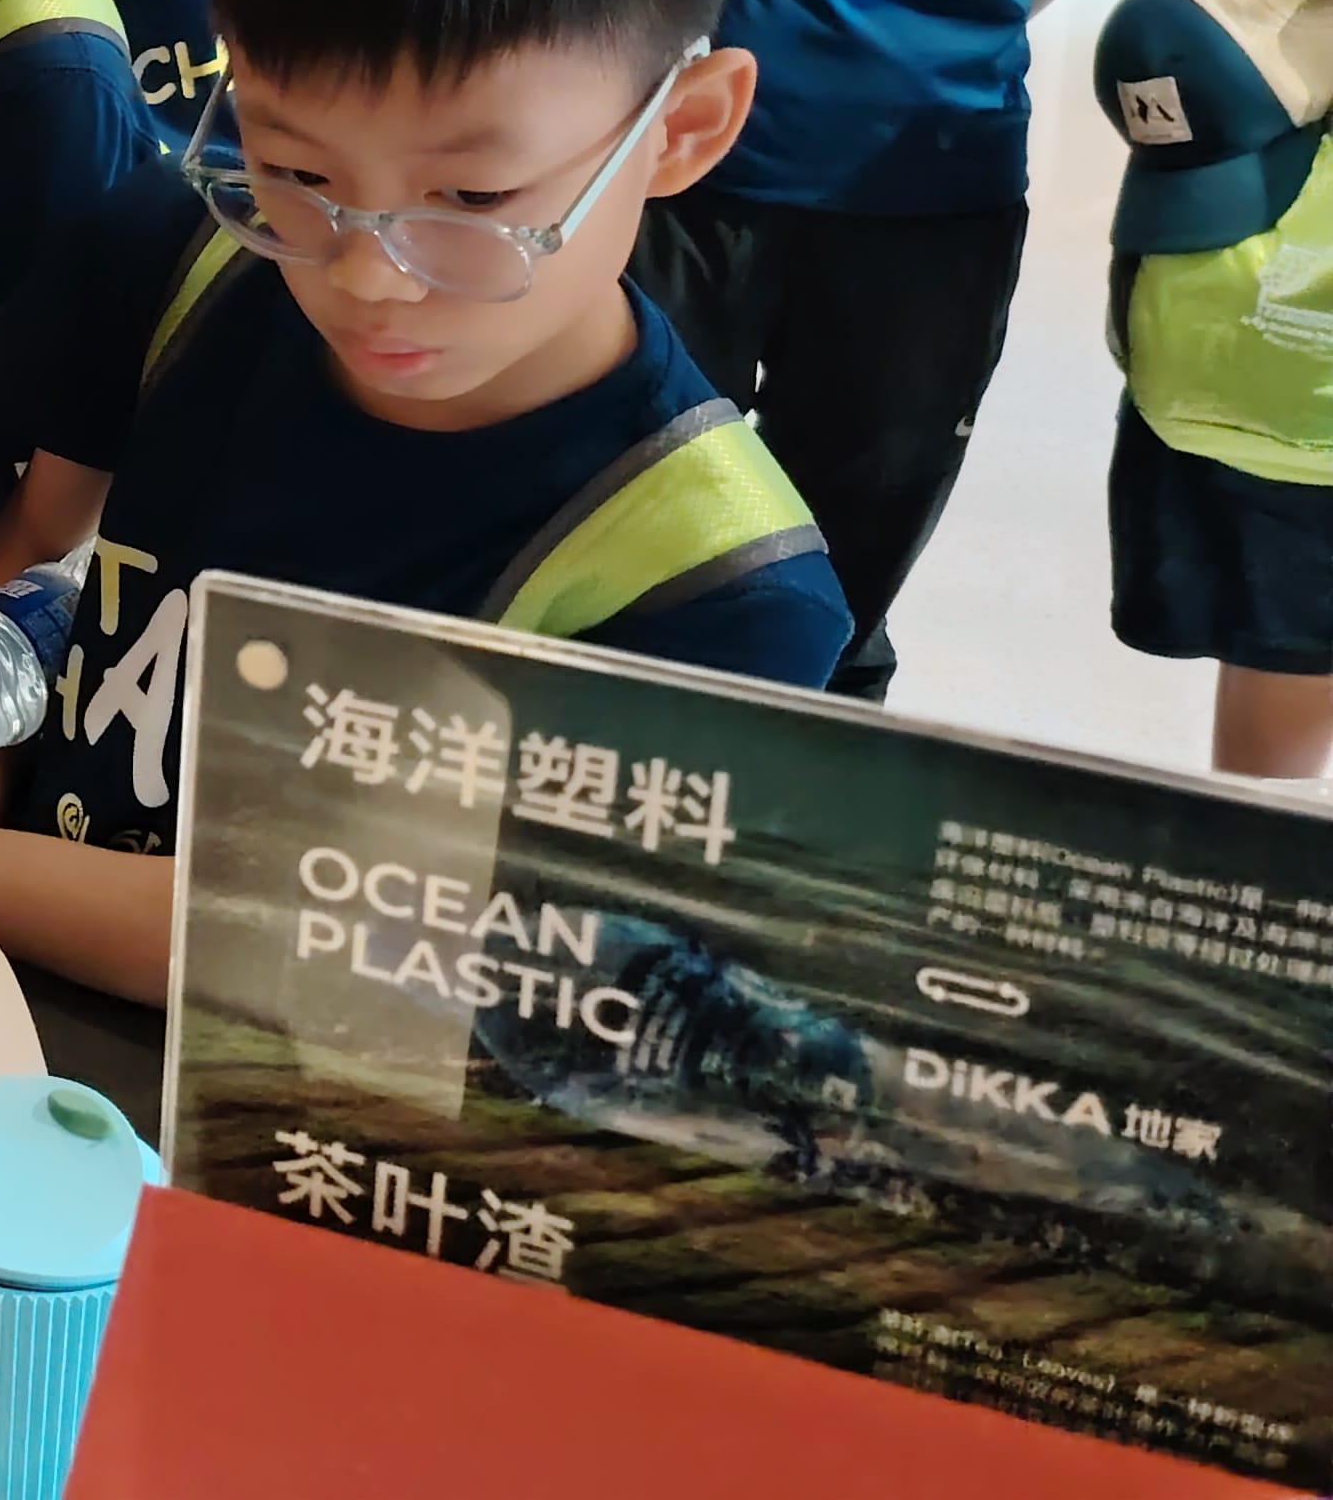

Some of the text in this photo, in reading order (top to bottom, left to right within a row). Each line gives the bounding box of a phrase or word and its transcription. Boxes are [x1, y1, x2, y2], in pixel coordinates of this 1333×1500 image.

[300, 681, 735, 865] 海洋塑料
[296, 845, 601, 968] OCEAN
[293, 912, 642, 1050] PLASTIC
[903, 1048, 1225, 1162] DiKKA 地家
[272, 1129, 578, 1287] 茶叶渣
